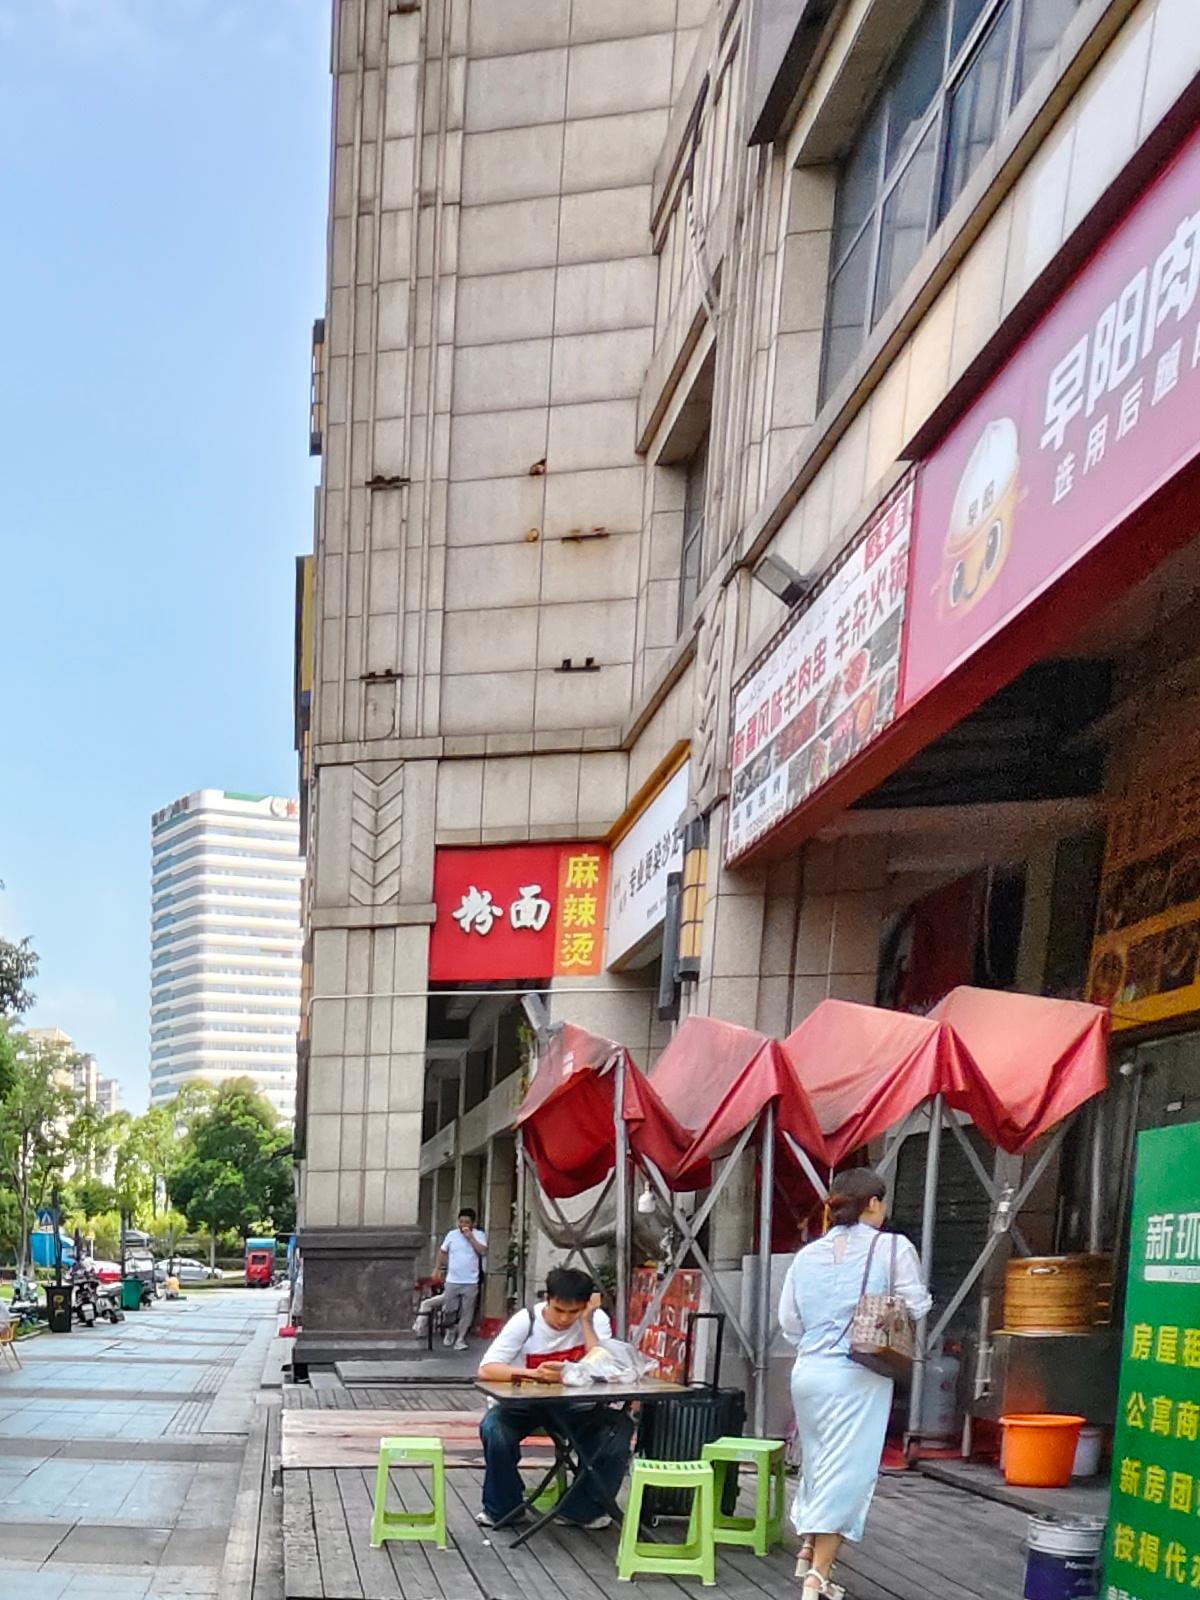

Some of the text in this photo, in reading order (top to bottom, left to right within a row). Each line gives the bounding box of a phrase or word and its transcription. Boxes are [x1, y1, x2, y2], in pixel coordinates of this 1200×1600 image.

[1052, 319, 1200, 505] 选用后腿
[452, 885, 551, 936] 粉面
[559, 853, 600, 968] 麻辣烫
[1126, 1391, 1200, 1440] 公寓商
[1119, 1456, 1200, 1517] 新房团
